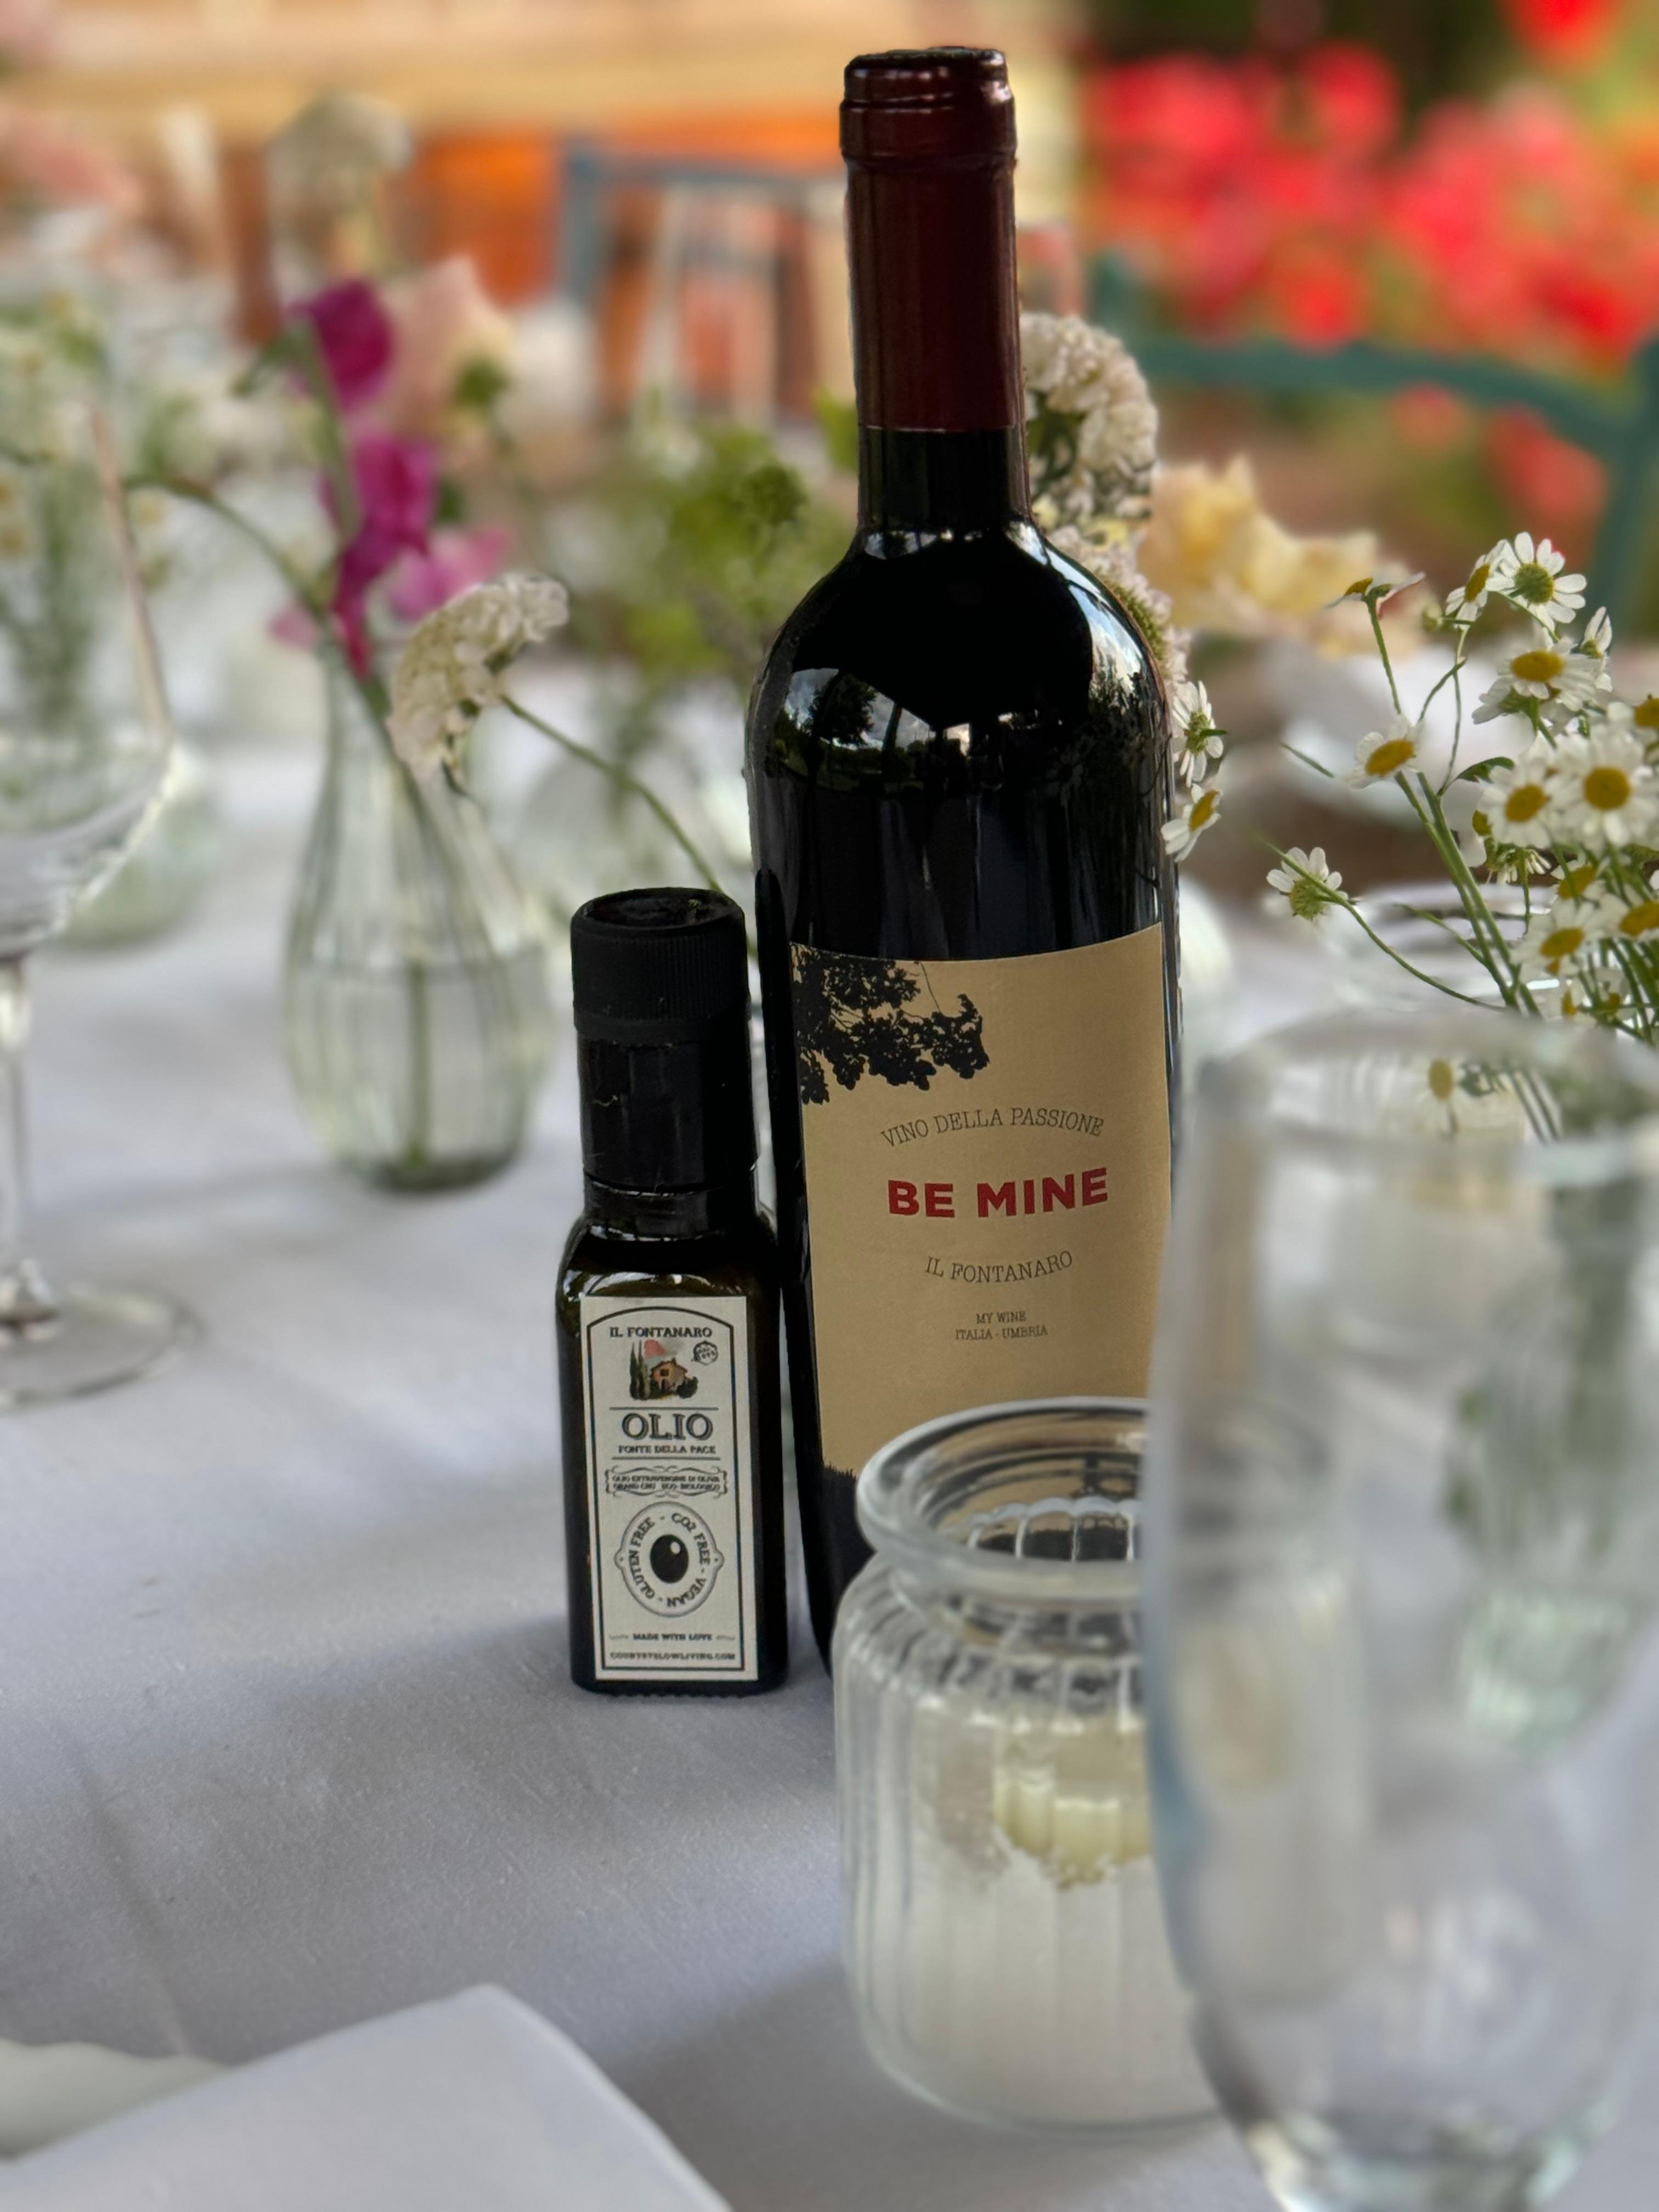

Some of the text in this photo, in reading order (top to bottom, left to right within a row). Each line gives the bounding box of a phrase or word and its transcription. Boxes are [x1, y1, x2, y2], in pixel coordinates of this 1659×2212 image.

[881, 1107, 1104, 1147] VINO DELLA PASSIONE
[888, 1167, 1108, 1218] BE MINE
[924, 1250, 1073, 1283] IL FONTANARO
[955, 1324, 1048, 1340] ITALIA UMBRIA
[976, 1311, 1026, 1324] MY WINE
[610, 1327, 712, 1338] IL FONTANARO
[621, 1413, 714, 1441] OLIO
[618, 1445, 716, 1454] FONTE DELLA PACE
[672, 1513, 710, 1565] CO2 FREE
[629, 1517, 656, 1599] GLUTEN FREE
[667, 1578, 707, 1607] VEGAN
